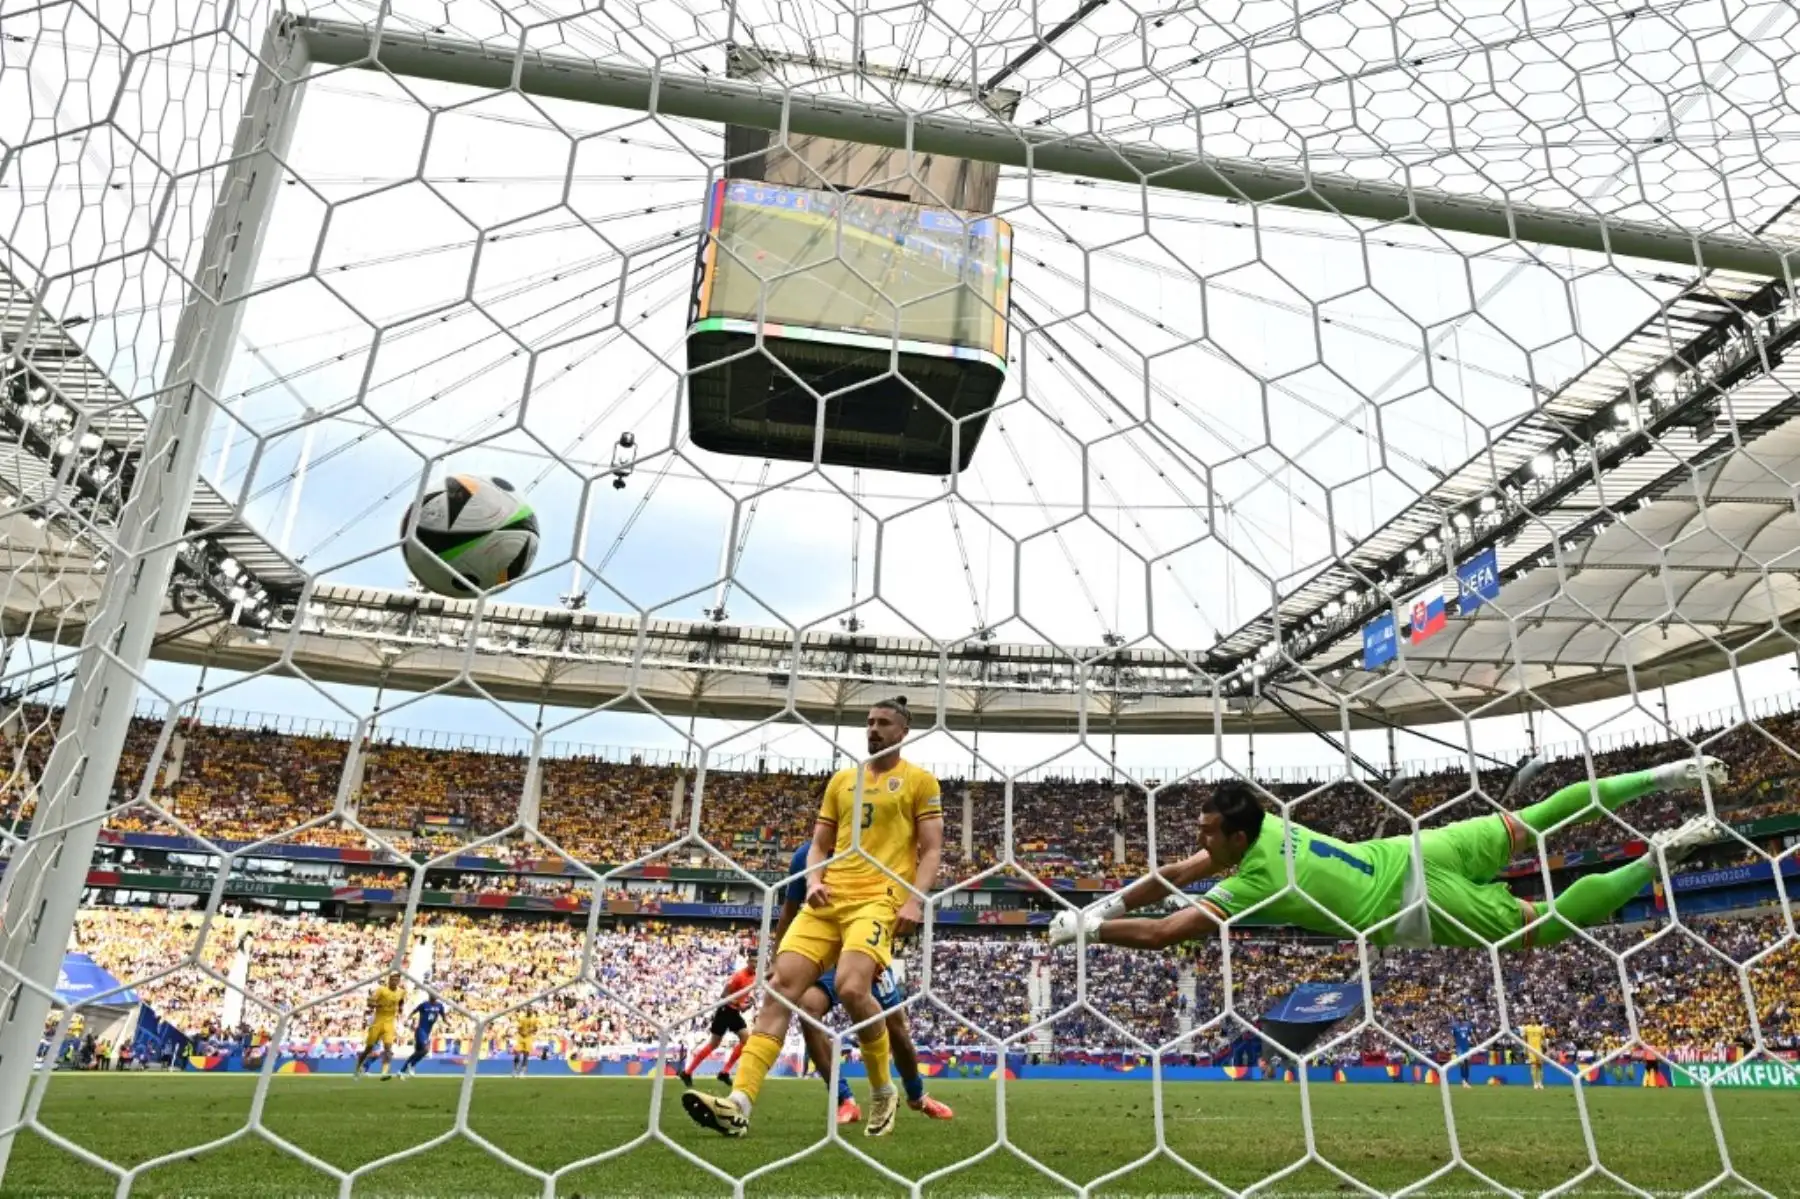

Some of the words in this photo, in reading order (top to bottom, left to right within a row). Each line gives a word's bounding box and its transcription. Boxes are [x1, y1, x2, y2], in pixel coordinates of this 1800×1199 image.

[1461, 566, 1494, 597] UEFA
[861, 802, 874, 829] 3
[1309, 839, 1375, 878] 1
[179, 877, 275, 893] FRAKFURT
[865, 920, 882, 946] 3
[1687, 1064, 1800, 1086] FRANKFUR
